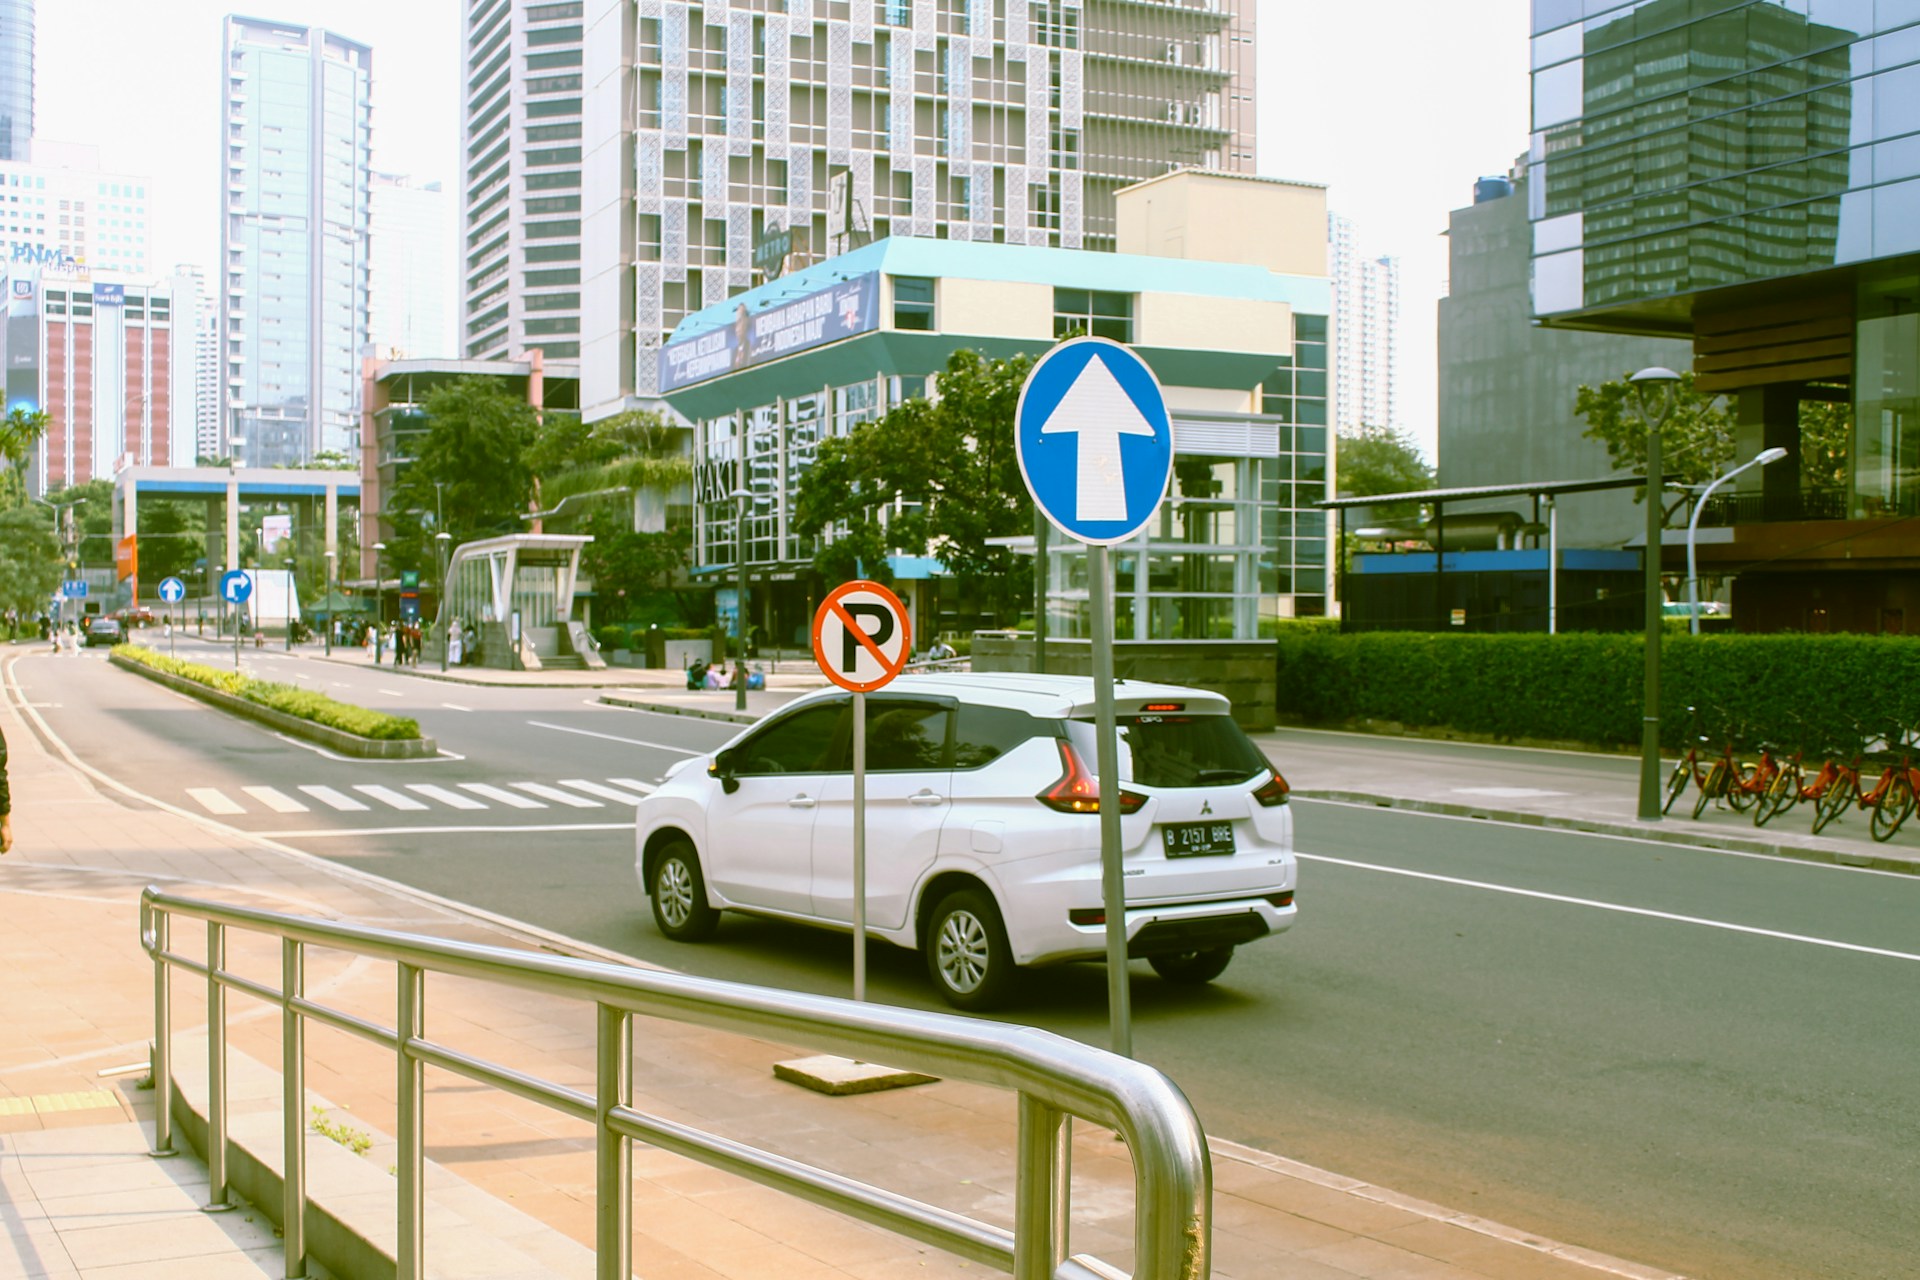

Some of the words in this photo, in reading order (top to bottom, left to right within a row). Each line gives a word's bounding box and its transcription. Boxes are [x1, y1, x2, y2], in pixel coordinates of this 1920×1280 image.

[12, 245, 63, 264] PNM
[756, 236, 790, 262] METRO
[843, 603, 894, 673] P
[1166, 829, 1175, 846] B
[1181, 827, 1205, 845] 2157
